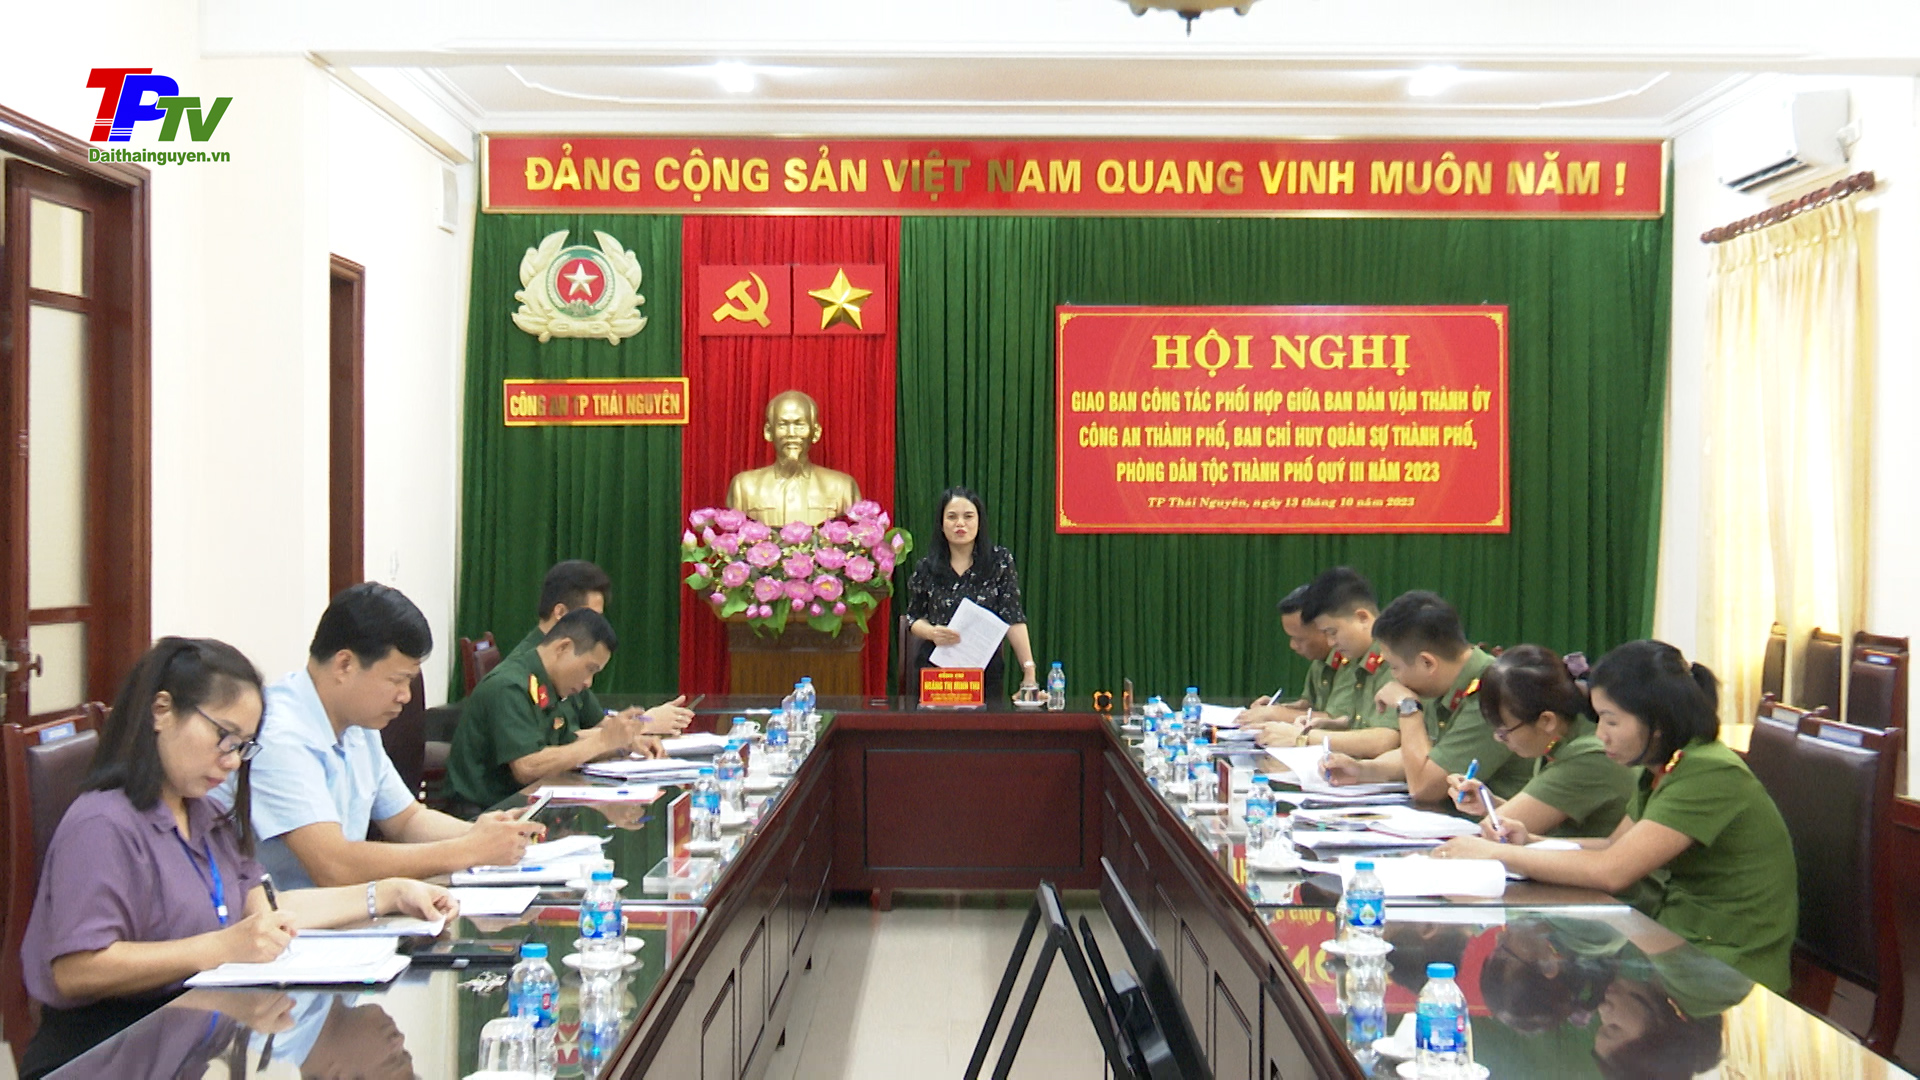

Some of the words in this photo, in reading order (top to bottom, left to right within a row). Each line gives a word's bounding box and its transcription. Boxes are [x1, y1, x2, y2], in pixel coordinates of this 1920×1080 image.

[524, 143, 641, 193] ĐẢNG
[654, 148, 770, 202] CỘNG
[784, 146, 867, 193] SẢN
[882, 150, 971, 201] VIỆT
[987, 159, 1082, 194] NAM
[1096, 159, 1244, 195] QUANG
[1259, 159, 1355, 196] VINH
[1370, 152, 1492, 196] MUÔN
[1508, 152, 1600, 196] NĂM
[1615, 162, 1626, 196] !
[1151, 327, 1255, 377] HỘI
[1271, 333, 1412, 376] NGHỊ
[509, 390, 546, 417] CÔNG
[550, 395, 569, 417] AN
[573, 394, 589, 417] TP
[592, 390, 623, 417] THÁI
[626, 389, 680, 417] NGUYÊN
[1071, 390, 1106, 412] GIAO
[1108, 391, 1138, 412] BAN
[1140, 386, 1181, 412] CÔNG
[1183, 386, 1212, 412] TÁC
[1214, 384, 1250, 412] PHỐI
[1253, 388, 1284, 415] HỢP
[1286, 386, 1321, 412] GIỮA
[1323, 390, 1354, 412] BAN
[1356, 386, 1386, 412] DÂN
[1388, 386, 1419, 416] VẬN
[1420, 386, 1470, 412] THÀNH
[1471, 384, 1492, 412] ỦY
[1078, 421, 1120, 448] CÔNG
[1121, 426, 1142, 447] AN
[1144, 421, 1193, 447] THÀNH
[1195, 419, 1231, 450] PHỐ,
[1233, 426, 1263, 447] BAN
[1265, 421, 1292, 448] CHỈ
[1294, 426, 1324, 448] HUY
[1326, 421, 1367, 449] QUÂN
[1368, 423, 1390, 451] SỰ
[1391, 421, 1441, 447] THÀNH
[1442, 419, 1478, 450] PHỐ,
[1115, 457, 1166, 483] PHÒNG
[1168, 457, 1198, 482] DÂN
[1200, 457, 1229, 487] TỘC
[1231, 457, 1281, 482] THÀNH
[1282, 454, 1315, 482] PHỐ
[1316, 456, 1347, 484] QUÝ
[1348, 461, 1366, 482] III
[1367, 457, 1402, 483] NĂM
[1403, 460, 1441, 483] 2023
